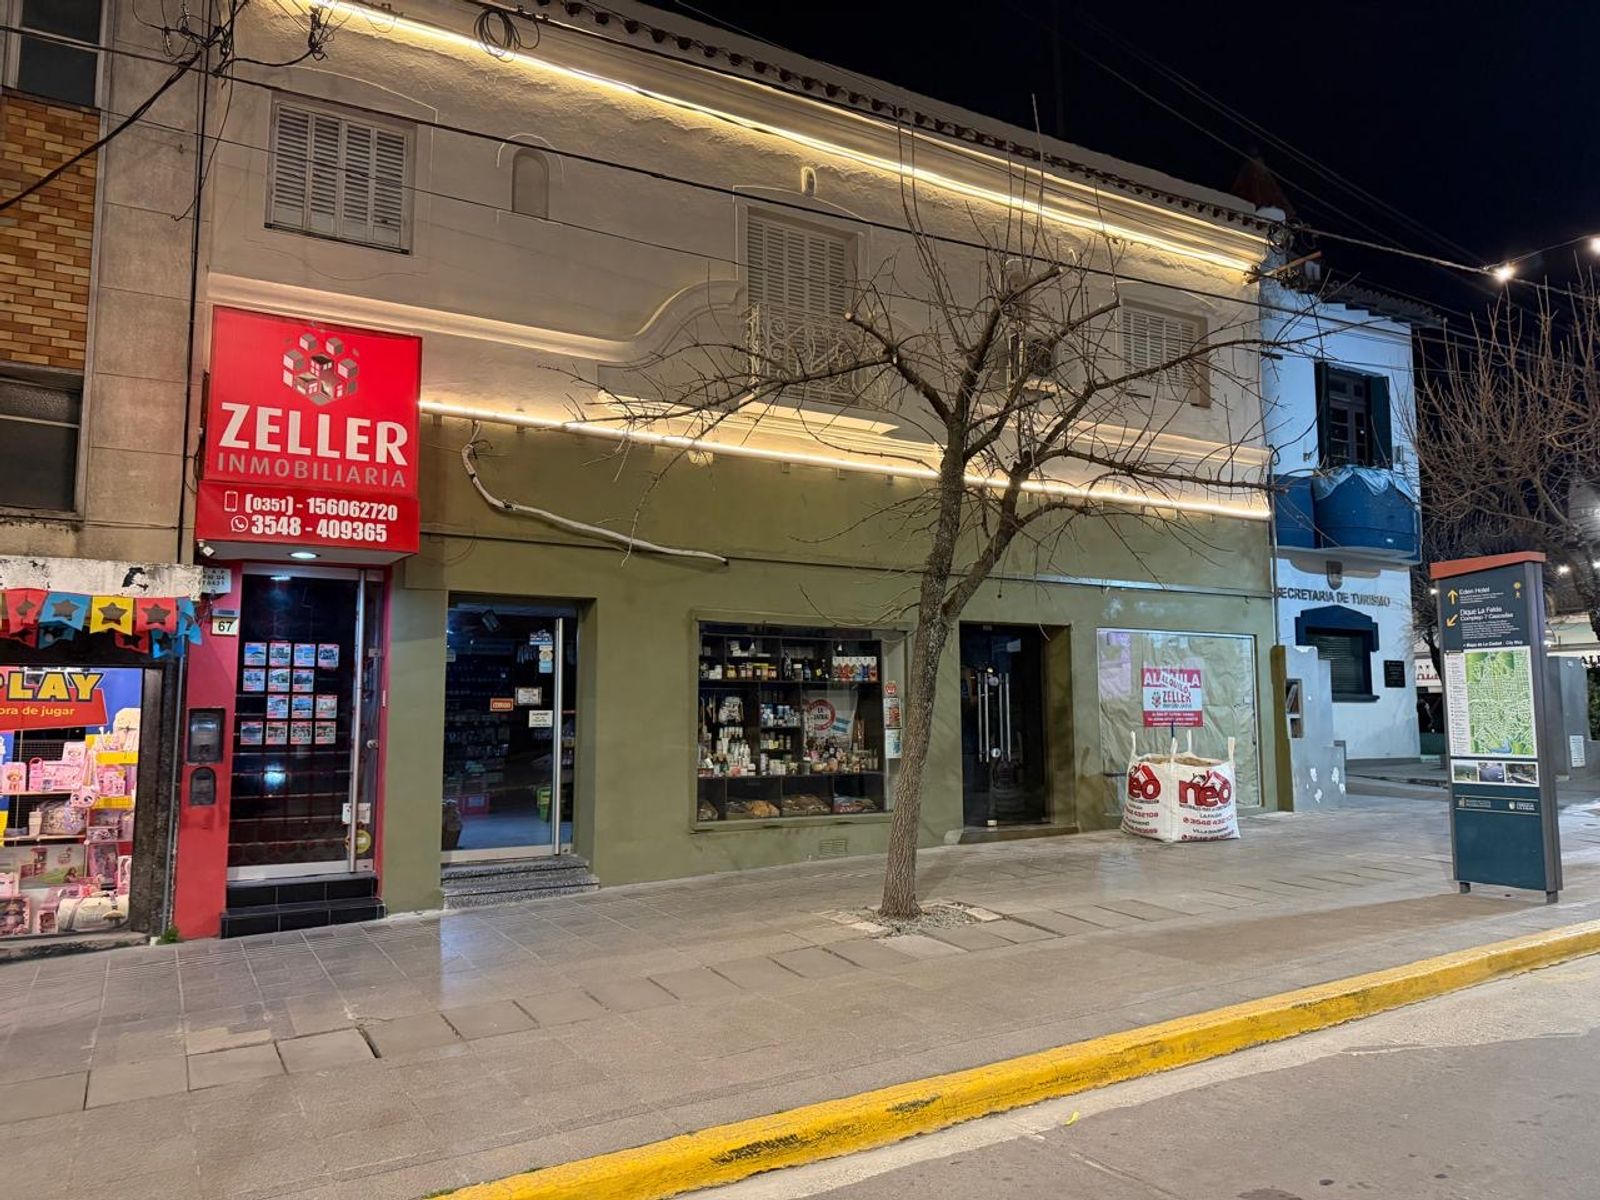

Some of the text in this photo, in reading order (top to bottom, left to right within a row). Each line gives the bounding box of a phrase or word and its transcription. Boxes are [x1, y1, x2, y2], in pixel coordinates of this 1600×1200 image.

[219, 402, 408, 466] ZELLER
[218, 452, 406, 488] INMOBILIARIA
[245, 493, 294, 515] (0351)
[306, 497, 398, 521] 156062720
[251, 515, 301, 536] 3548
[316, 519, 387, 542] 409365
[1336, 592, 1349, 603] DE
[1351, 593, 1390, 607] TURISMO
[218, 621, 233, 632] 67
[22, 706, 38, 715] de
[41, 706, 75, 717] jugar
[1179, 771, 1232, 807] neo
